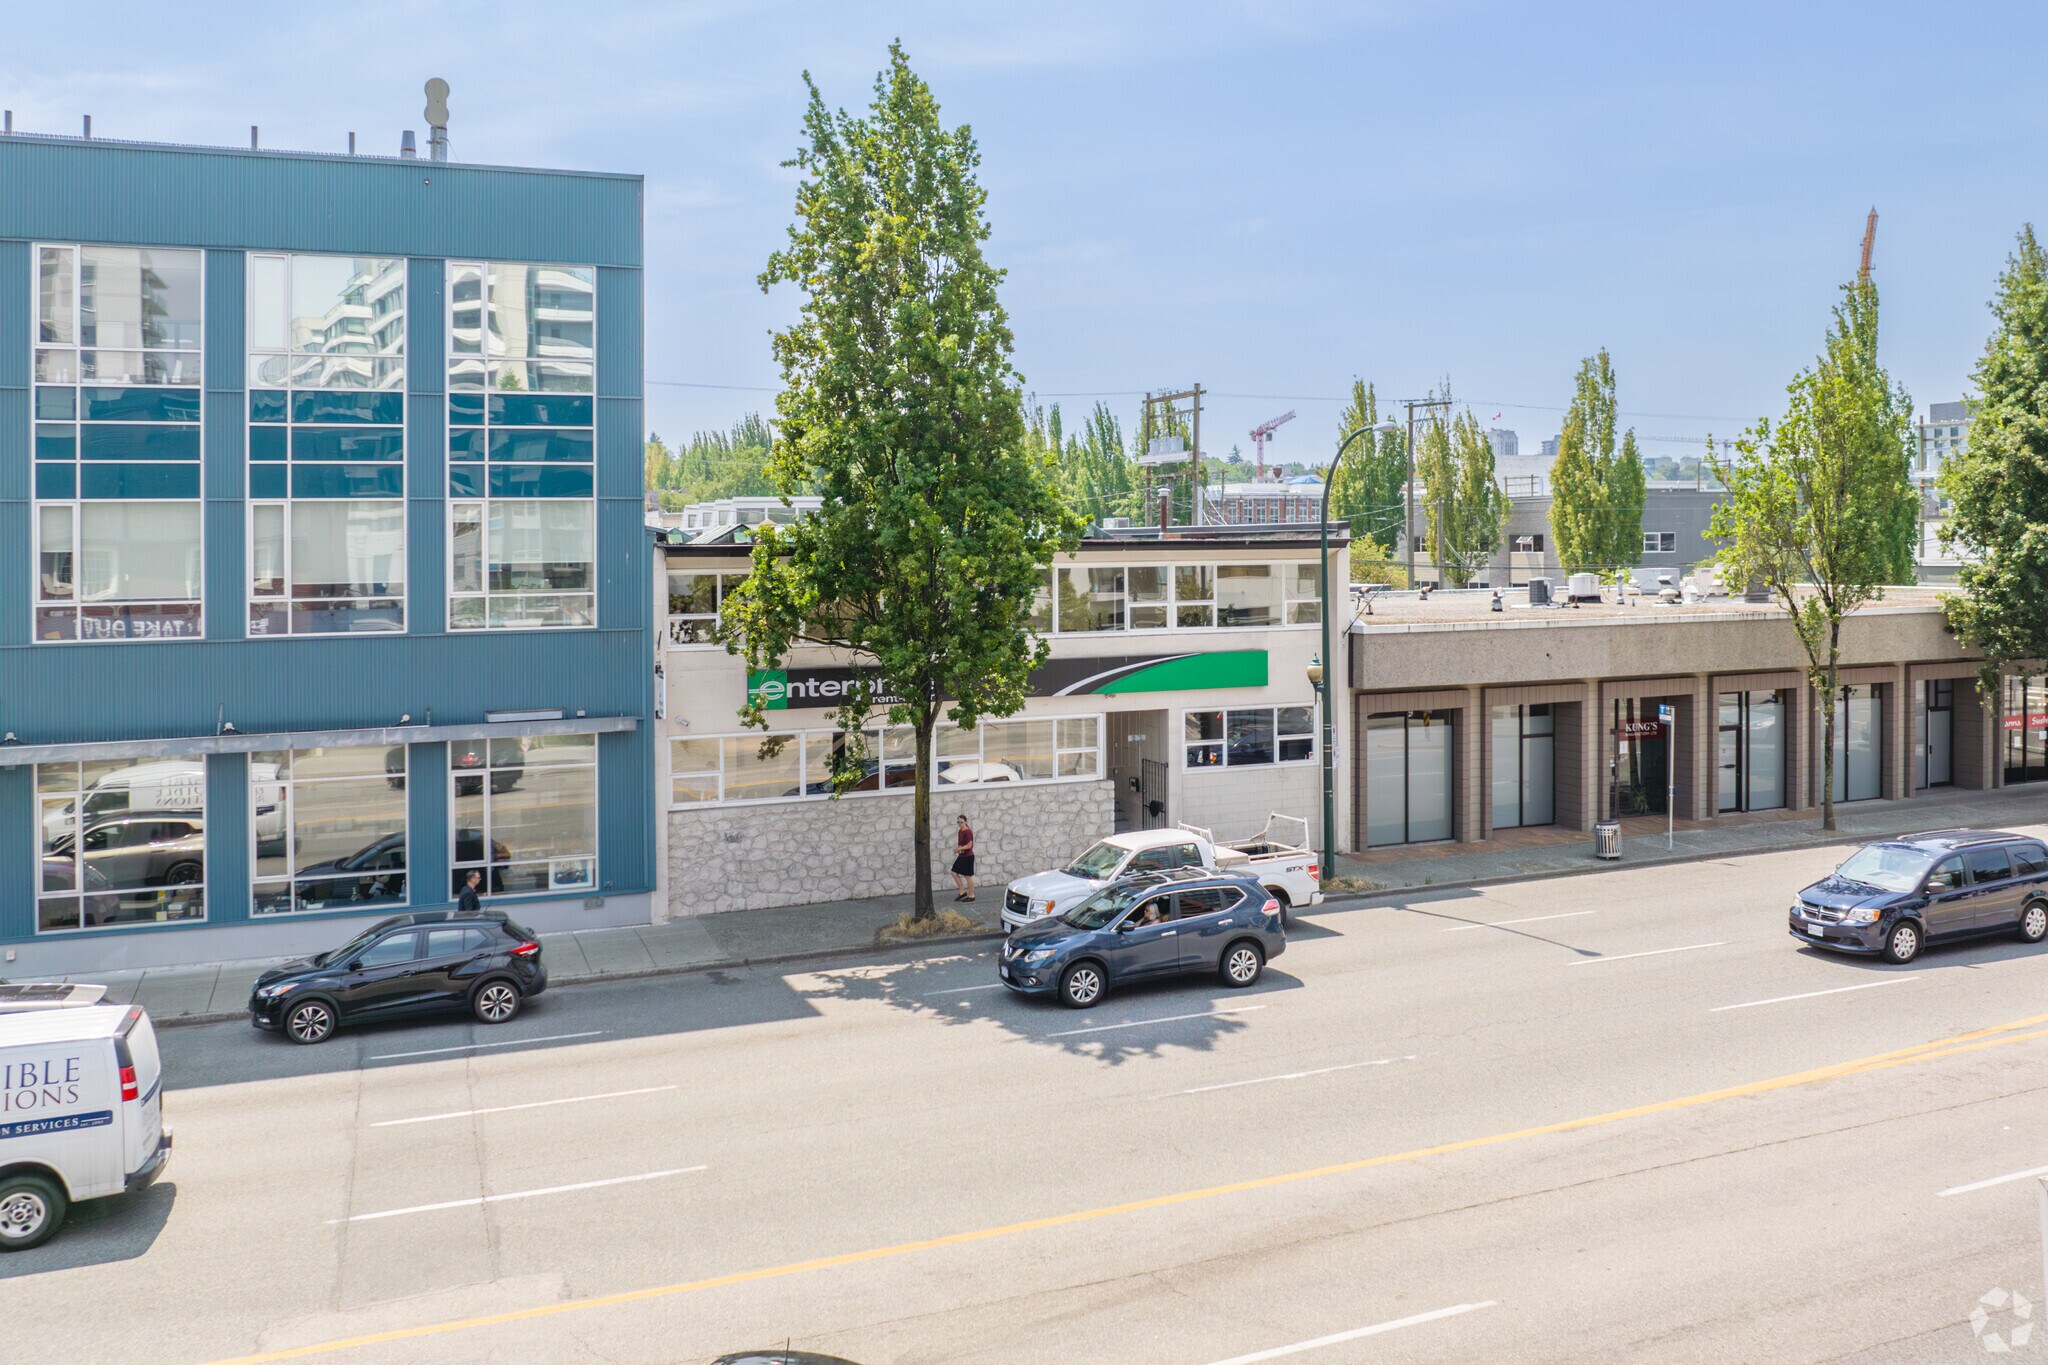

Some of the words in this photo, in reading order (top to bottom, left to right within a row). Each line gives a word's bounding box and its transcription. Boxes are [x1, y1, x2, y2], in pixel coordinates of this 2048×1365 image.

[1625, 721, 1658, 732] KUNG'S
[1285, 865, 1304, 873] STX
[0, 1126, 10, 1136] N
[15, 1117, 79, 1134] SERVICES
